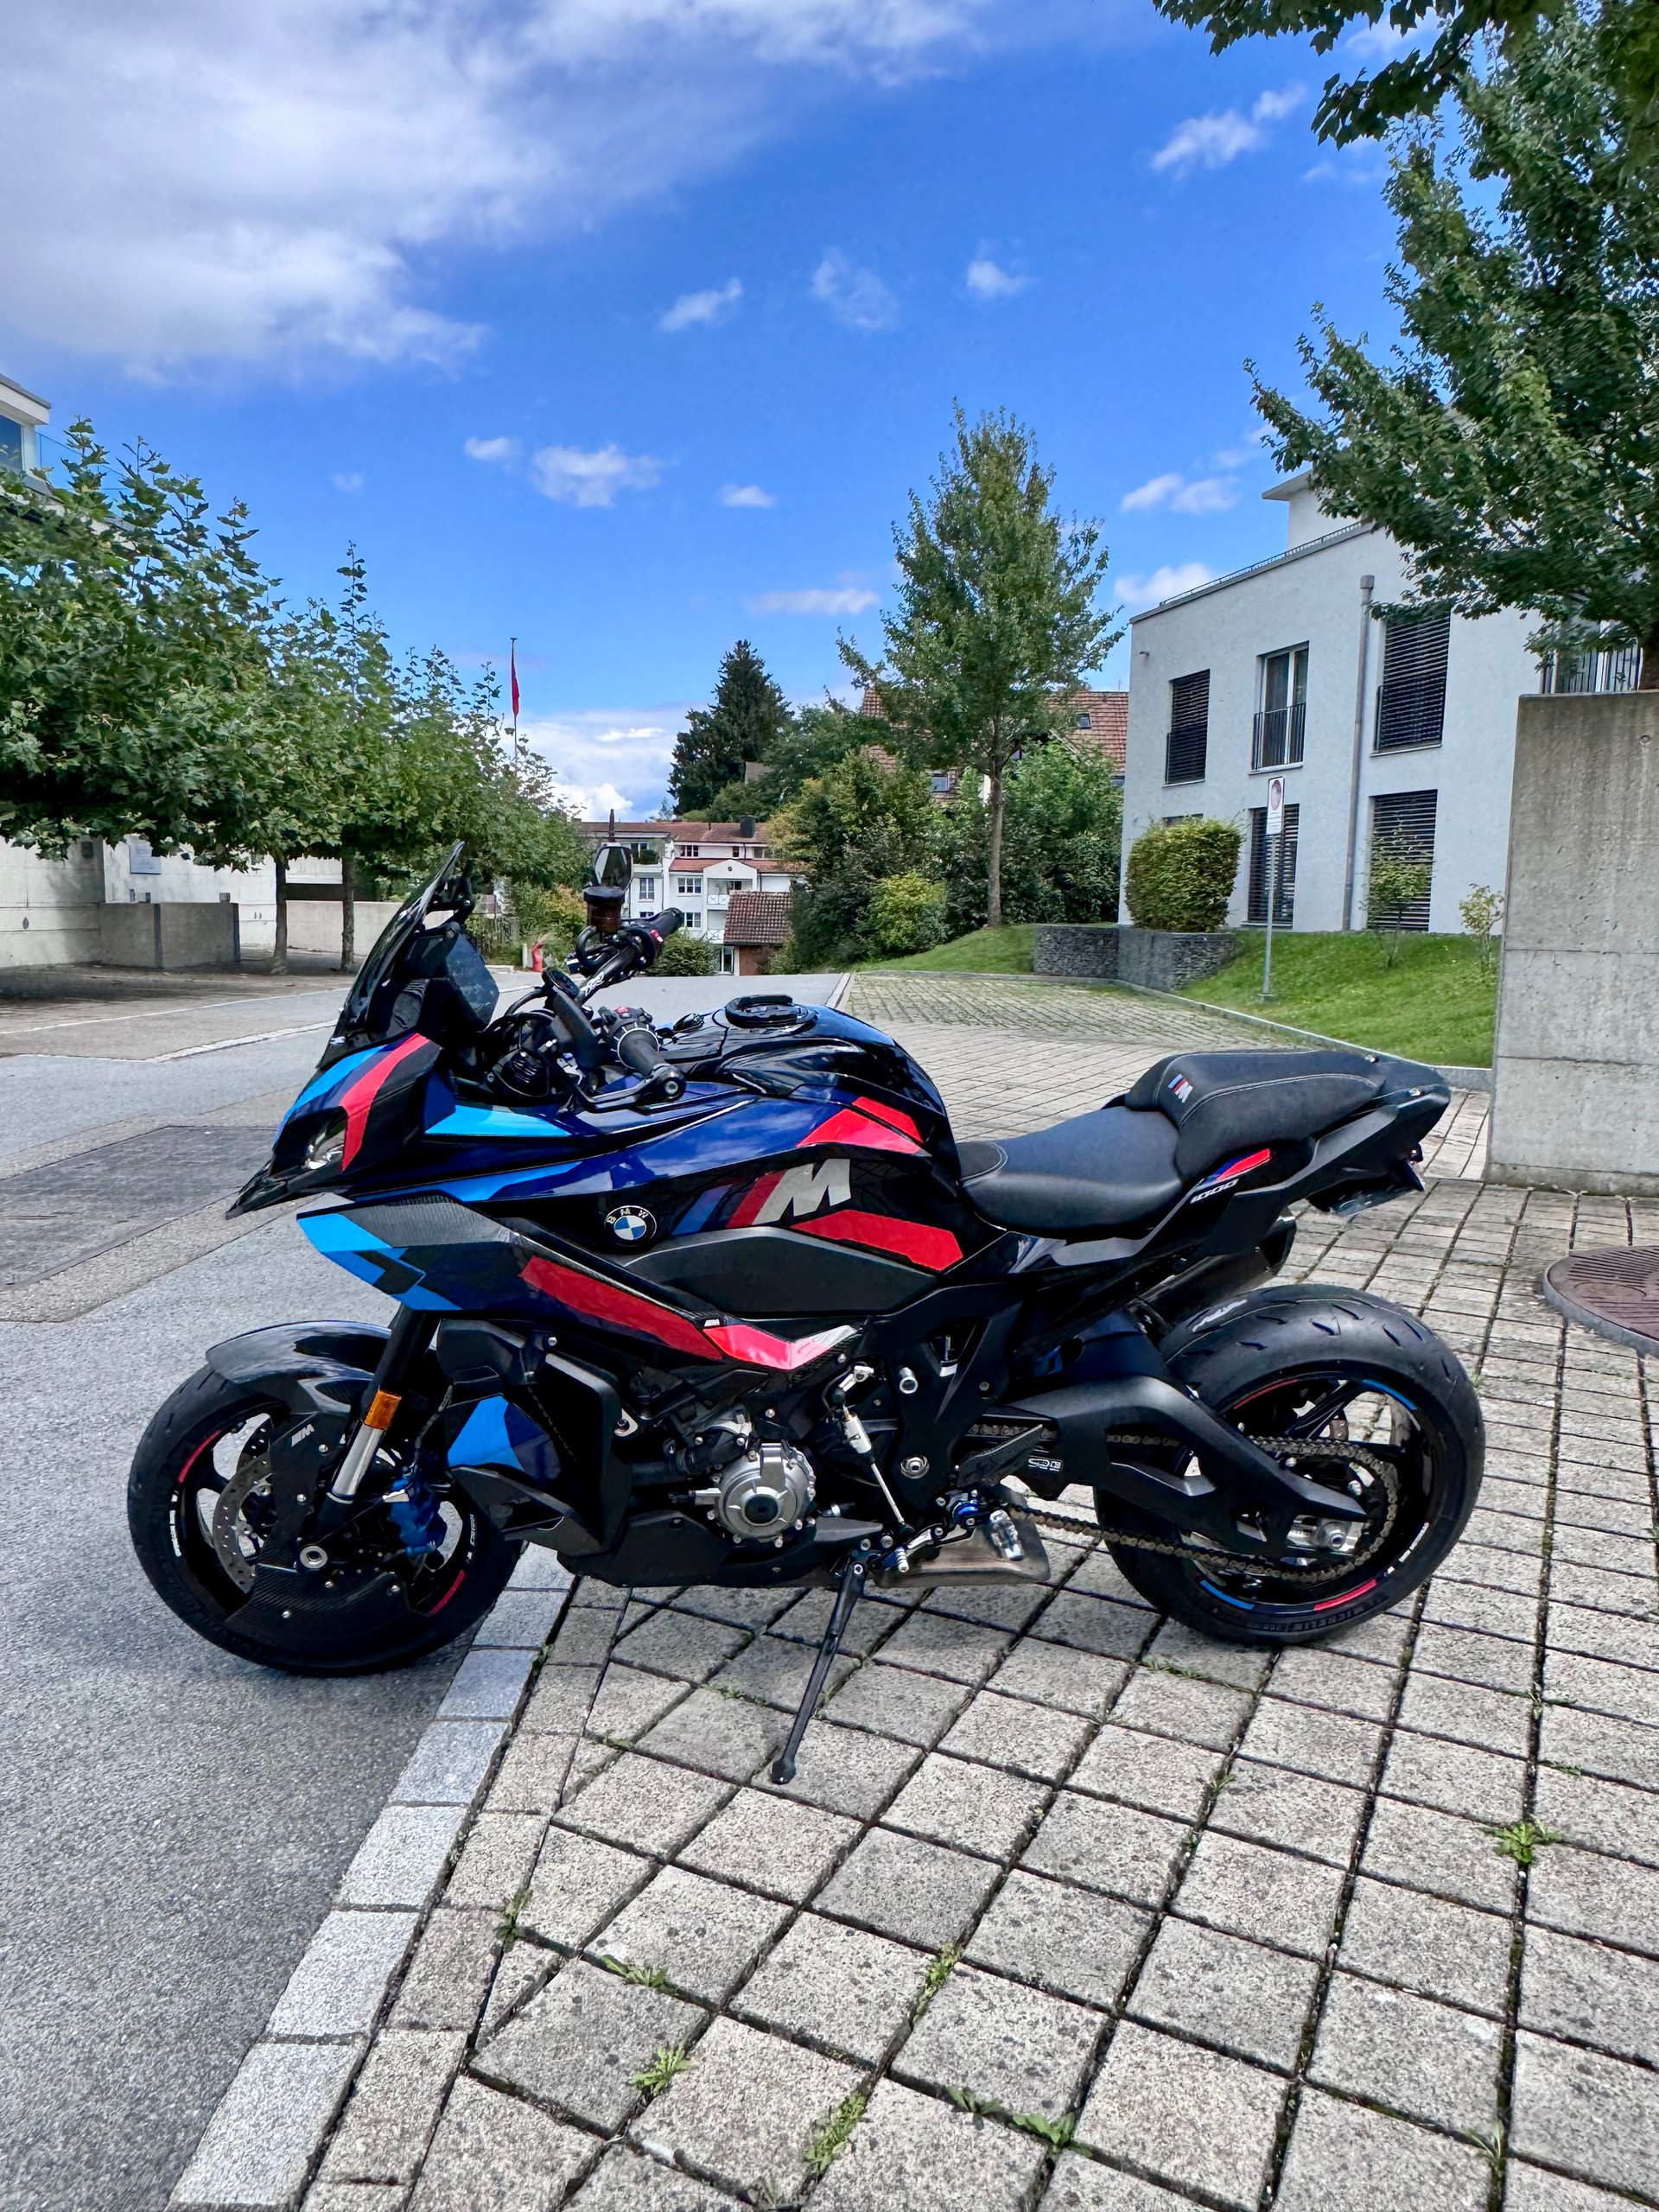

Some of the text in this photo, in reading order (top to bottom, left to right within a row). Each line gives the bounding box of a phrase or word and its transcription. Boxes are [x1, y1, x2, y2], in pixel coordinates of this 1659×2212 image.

[751, 1159, 851, 1225] M
[1191, 1178, 1239, 1203] 1000
[607, 1208, 649, 1224] BMW
